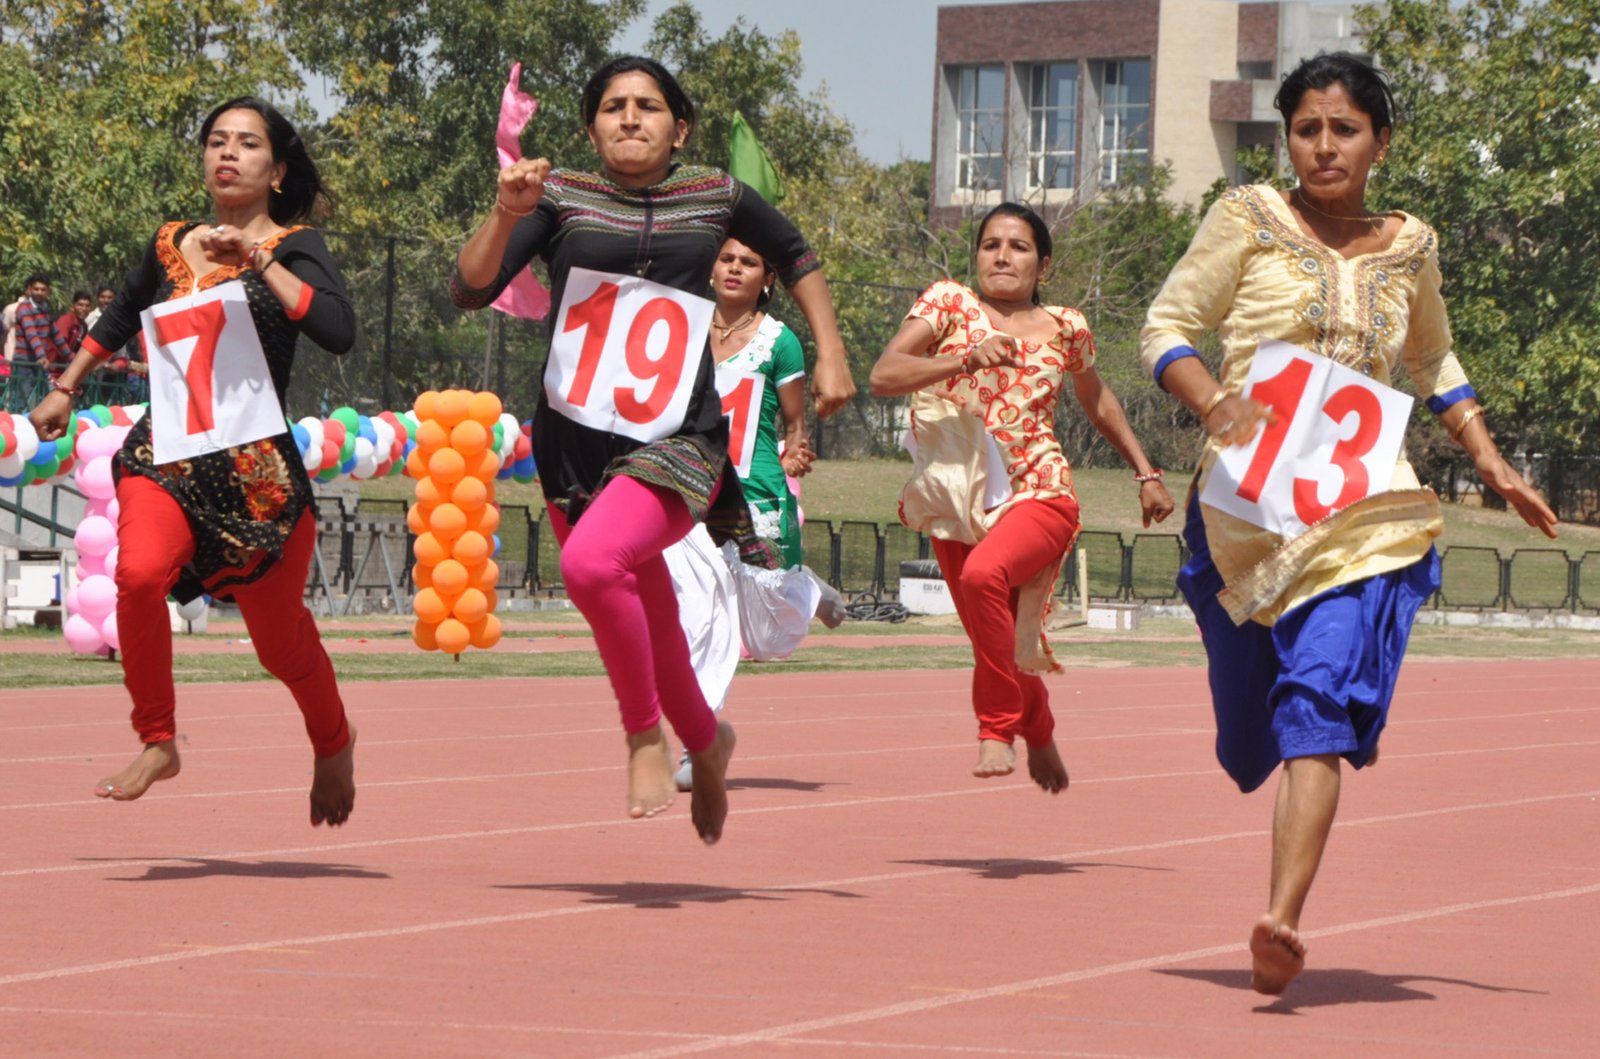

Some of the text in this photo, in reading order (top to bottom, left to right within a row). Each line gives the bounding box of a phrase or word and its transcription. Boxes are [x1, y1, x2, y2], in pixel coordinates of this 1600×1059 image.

[154, 298, 228, 436] 7
[562, 281, 689, 425] 19
[1235, 356, 1383, 528] 13
